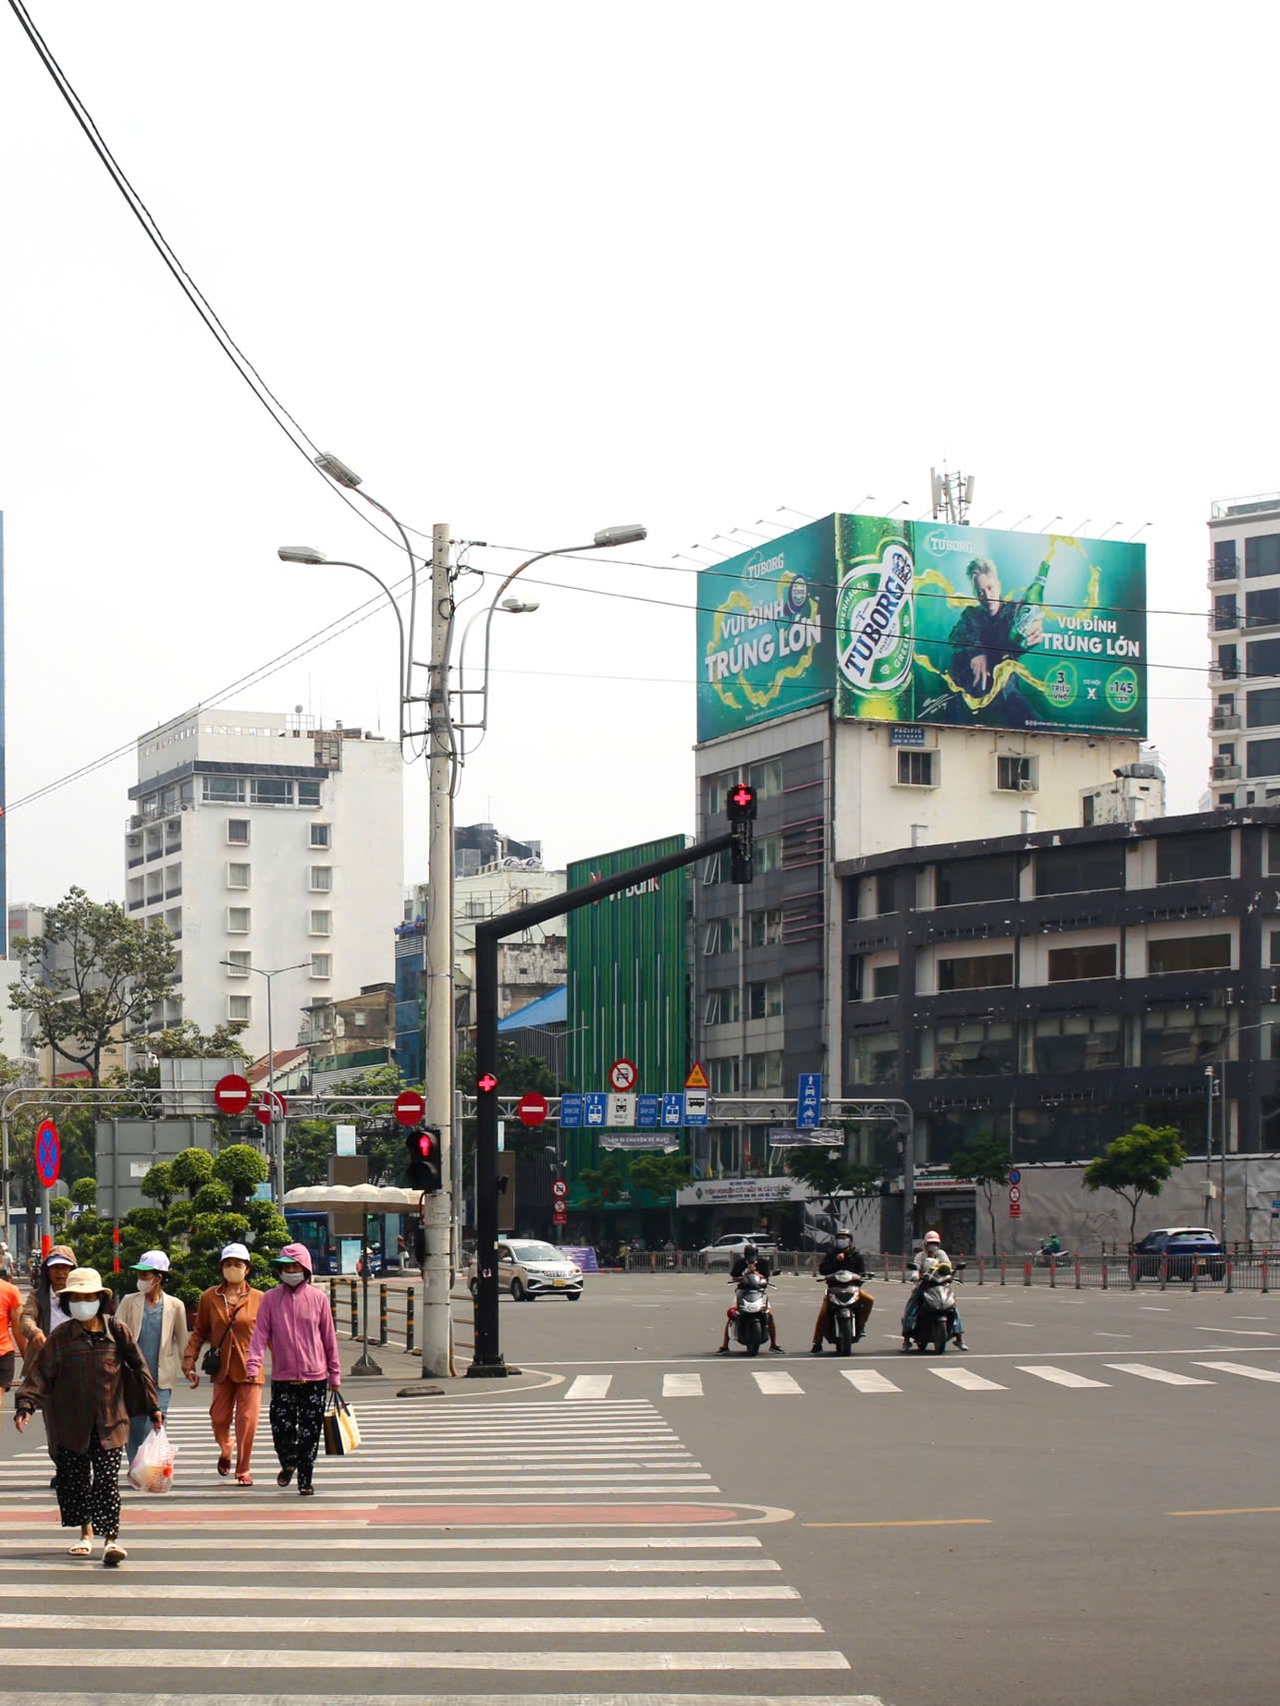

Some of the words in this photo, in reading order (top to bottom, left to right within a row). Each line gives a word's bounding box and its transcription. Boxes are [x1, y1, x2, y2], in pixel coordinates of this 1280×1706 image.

[931, 537, 974, 554] TUBORG
[748, 552, 784, 580] TUBORG
[722, 615, 745, 639] VUI
[845, 575, 905, 677] TUBORG
[1058, 616, 1080, 630] VUI
[1083, 615, 1117, 633] ĐỈNH
[705, 634, 775, 682] TRÚNG
[779, 614, 821, 657] LỚN
[1042, 631, 1102, 653] TRÚNG
[1107, 636, 1140, 657] LỚN
[1057, 672, 1065, 684] 3
